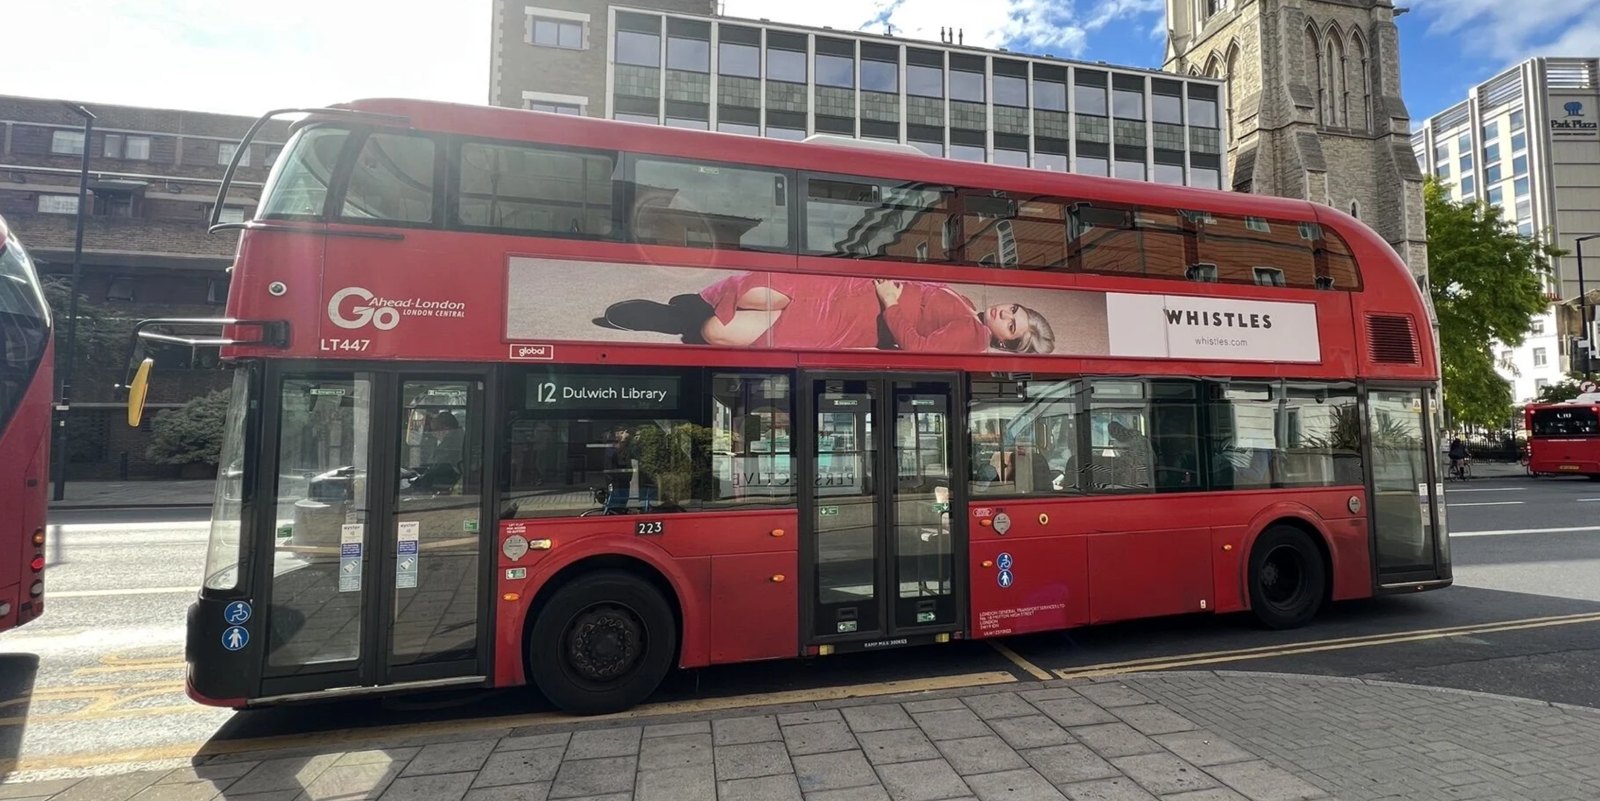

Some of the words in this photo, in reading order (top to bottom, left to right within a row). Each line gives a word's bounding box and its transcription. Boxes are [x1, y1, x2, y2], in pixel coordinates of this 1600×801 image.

[1551, 120, 1571, 128] Park
[1572, 120, 1597, 128] Plaza
[328, 286, 400, 330] Go
[369, 297, 465, 309] Ahead-London
[403, 309, 433, 317] LONDON
[435, 310, 465, 318] CENTRAL
[1163, 309, 1272, 329] WHISTLES
[320, 338, 371, 352] LT447
[1195, 336, 1248, 347] whistles.com
[518, 346, 545, 357] global
[537, 382, 557, 403] 12
[563, 386, 618, 400] Dulwich
[621, 387, 667, 402] Library
[638, 521, 662, 534] 223
